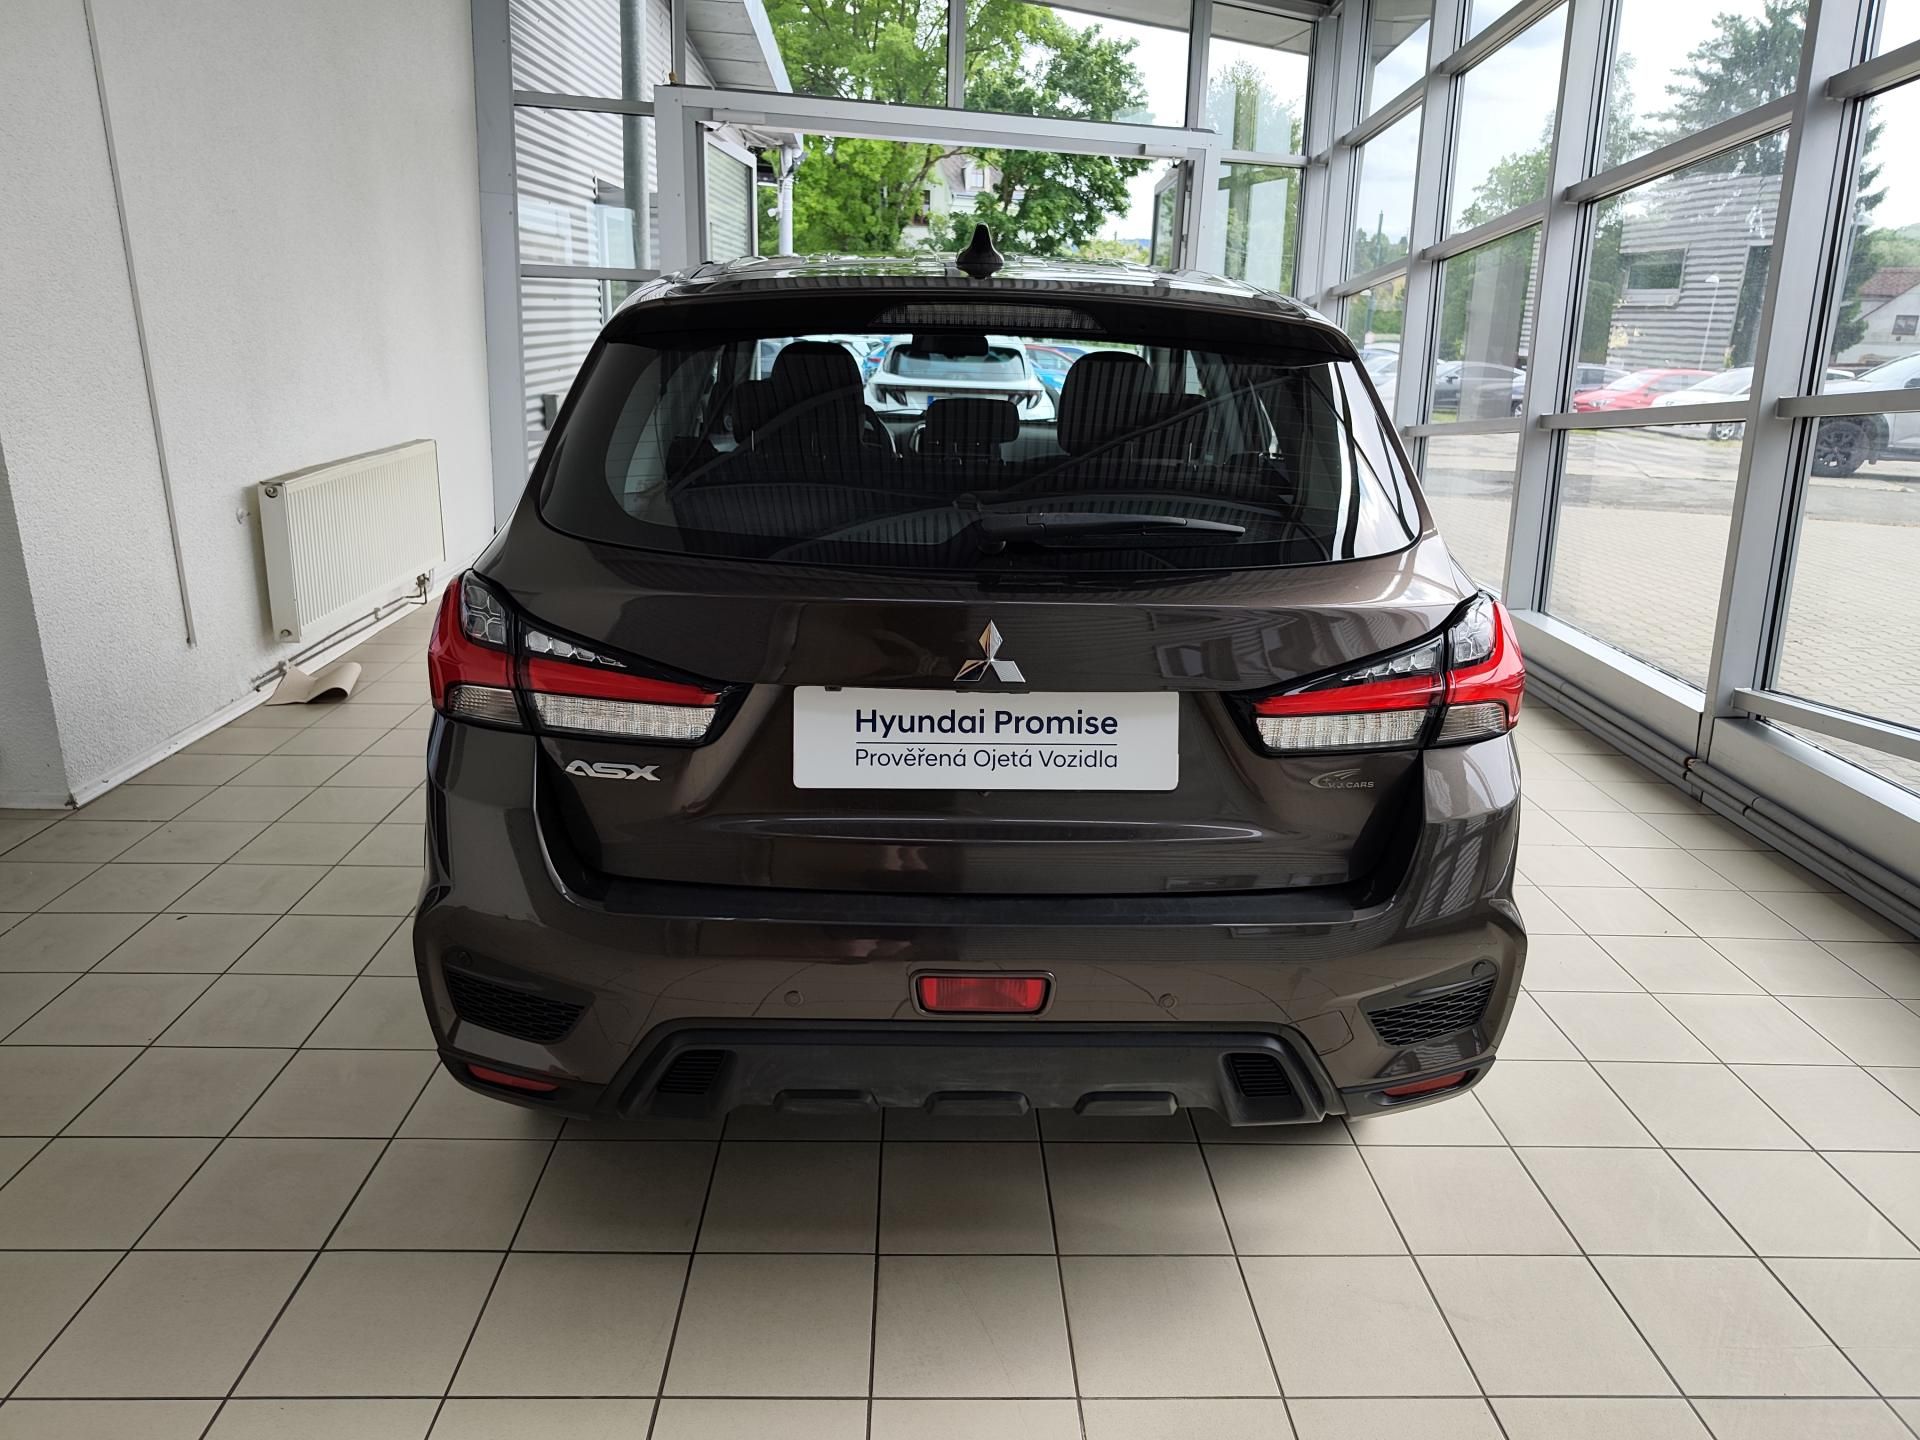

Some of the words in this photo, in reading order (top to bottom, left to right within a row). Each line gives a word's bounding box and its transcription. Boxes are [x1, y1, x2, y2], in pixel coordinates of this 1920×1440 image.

[855, 708, 985, 739] Hyundai
[994, 709, 1118, 735] Promise
[565, 759, 661, 781] ASX
[855, 747, 966, 767] Prověřená
[973, 748, 1032, 771] Ojetá
[1038, 749, 1118, 768] Vozidla
